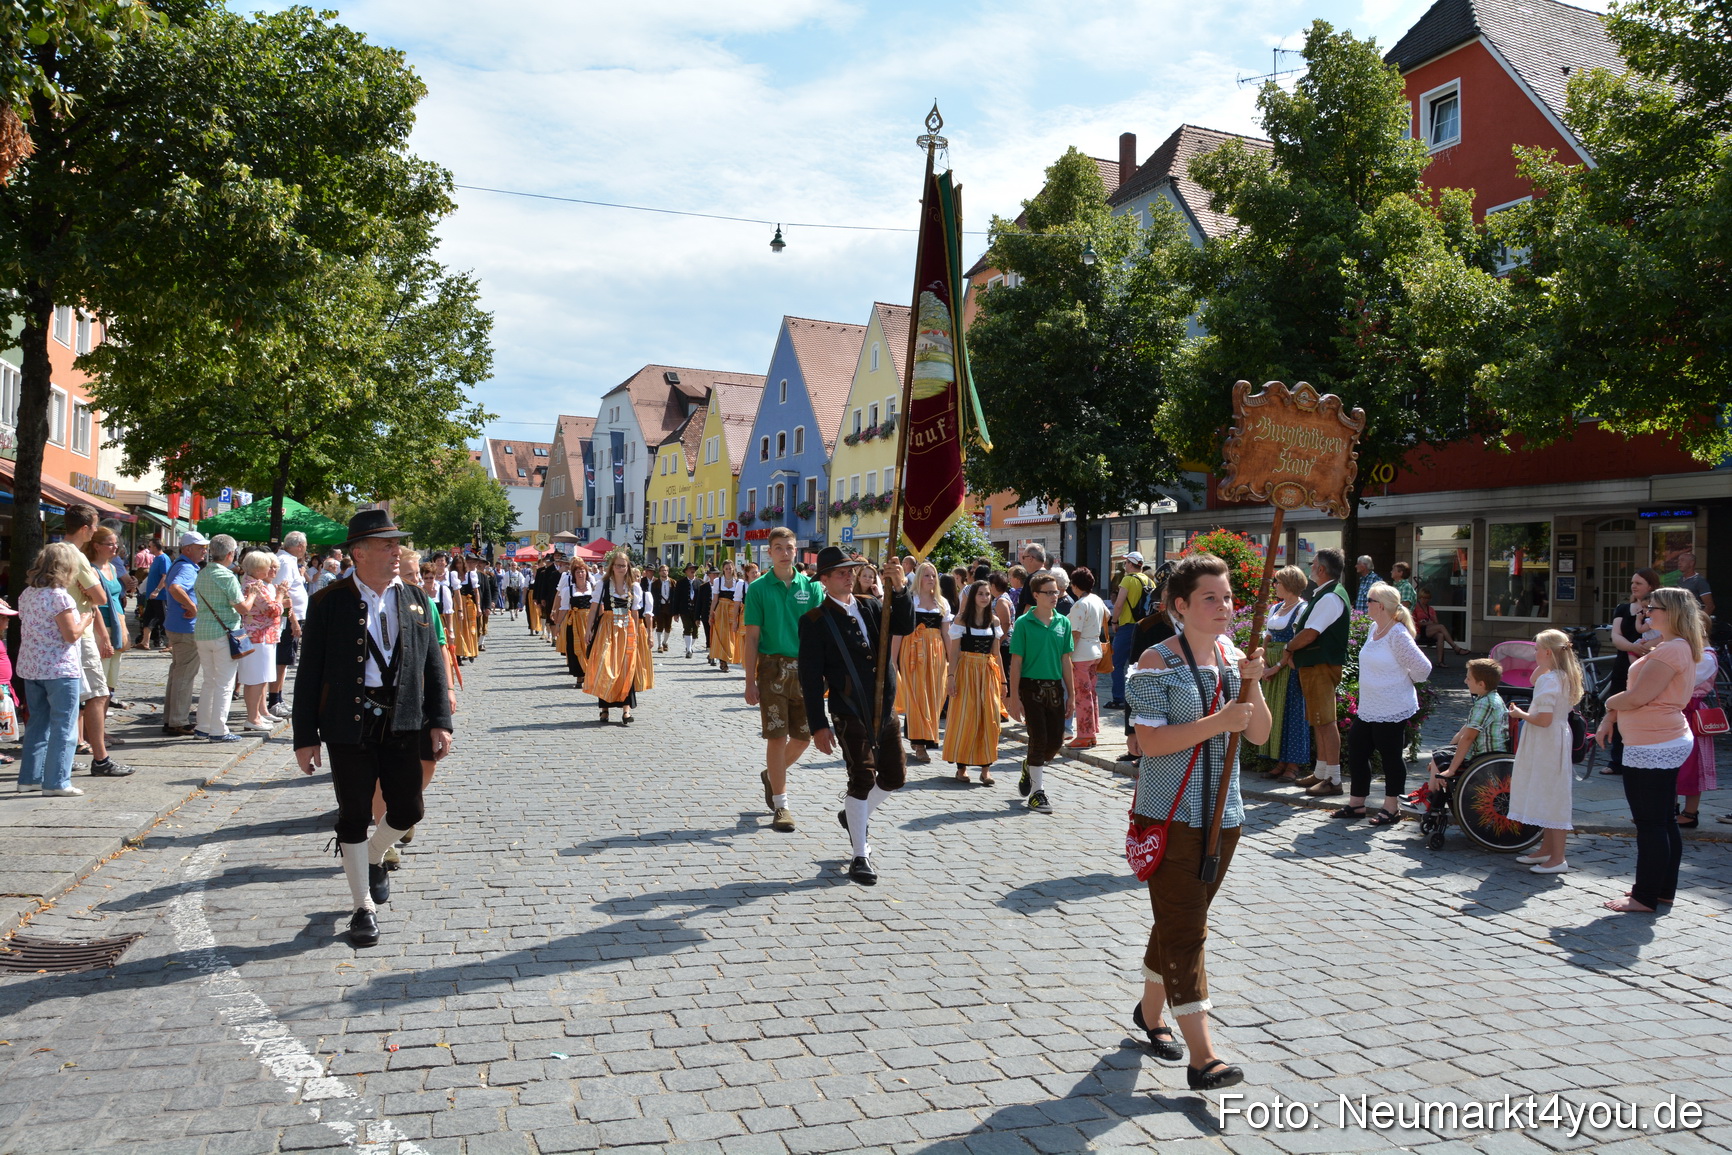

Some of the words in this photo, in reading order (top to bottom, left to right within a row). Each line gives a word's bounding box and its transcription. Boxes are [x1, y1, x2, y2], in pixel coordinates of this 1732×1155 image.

[221, 489, 229, 501] P
[666, 485, 677, 496] HOTEL
[844, 529, 851, 541] P
